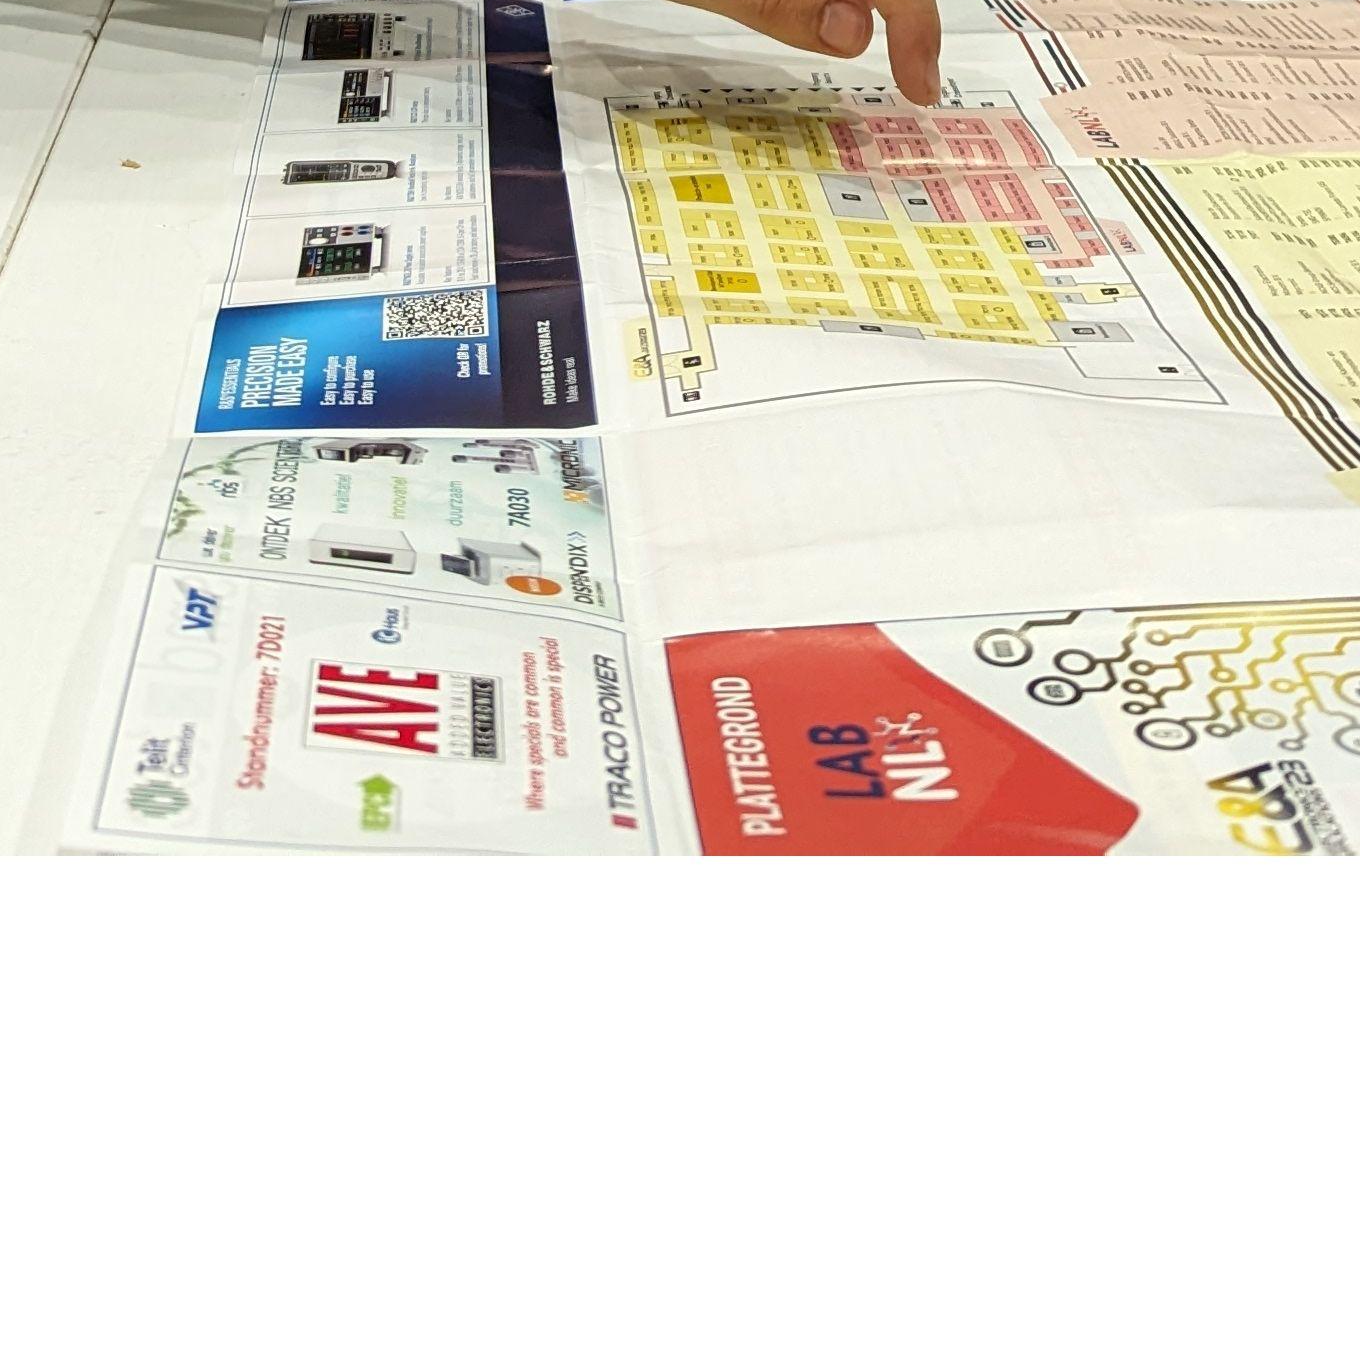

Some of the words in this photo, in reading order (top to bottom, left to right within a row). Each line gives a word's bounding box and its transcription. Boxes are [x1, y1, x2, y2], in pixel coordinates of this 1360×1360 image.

[276, 336, 308, 367] EASY
[536, 320, 557, 404] ROHDE&SCHWARZ
[238, 345, 278, 407] PRECISION
[273, 369, 304, 406] MADE
[319, 390, 339, 405] Easy
[339, 390, 359, 404] Easy
[358, 389, 379, 404] Easy
[267, 485, 298, 510] NBS
[389, 475, 410, 519] innovatief
[447, 480, 464, 526] duurzaam
[508, 487, 530, 527] 7A030
[259, 517, 292, 559] ONTDEK
[180, 586, 220, 631] VPT
[256, 615, 285, 660] 7D021
[308, 660, 443, 754] AVE
[593, 654, 626, 725] POWER
[234, 665, 281, 791] Standnummer:
[602, 732, 636, 810] TRACO
[712, 676, 787, 837] PLATTEGROND
[808, 723, 887, 800] LAB
[881, 738, 960, 802] NL
